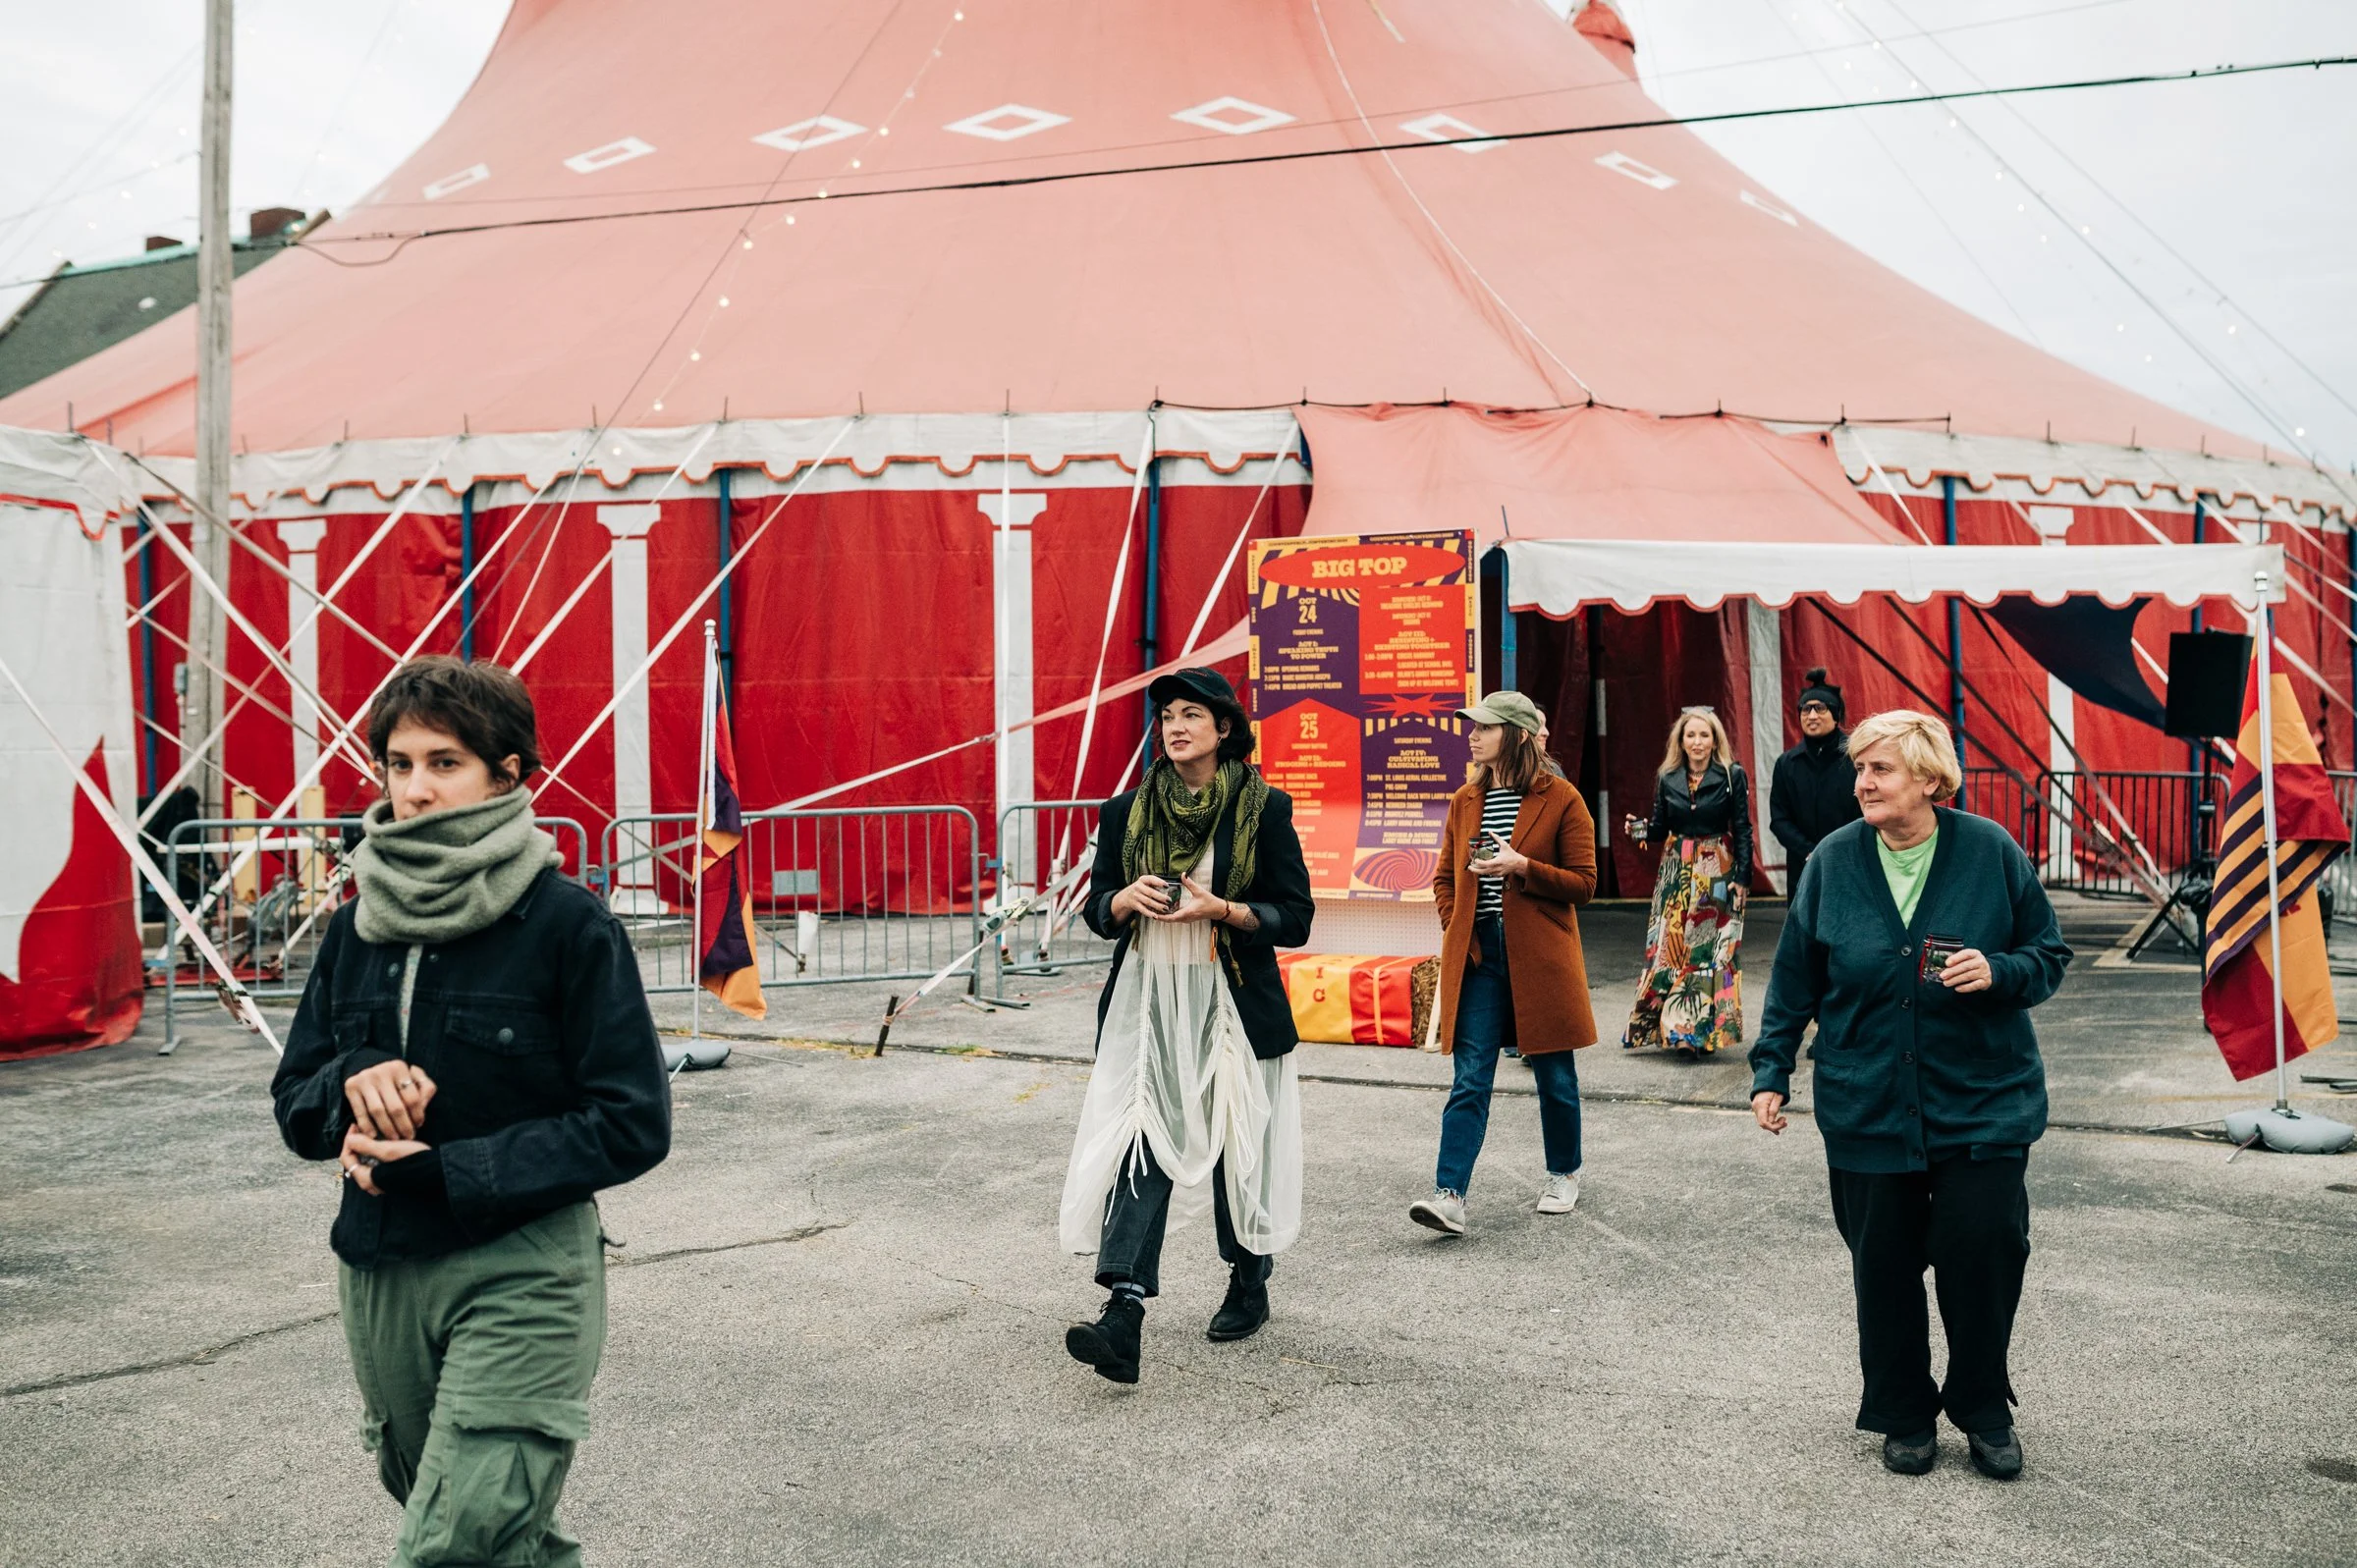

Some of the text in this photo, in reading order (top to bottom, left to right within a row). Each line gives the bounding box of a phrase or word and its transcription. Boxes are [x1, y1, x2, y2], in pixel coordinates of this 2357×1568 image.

[1311, 556, 1408, 579] BIG TOP
[1298, 605, 1317, 623] 24
[1300, 721, 1319, 739] 25
